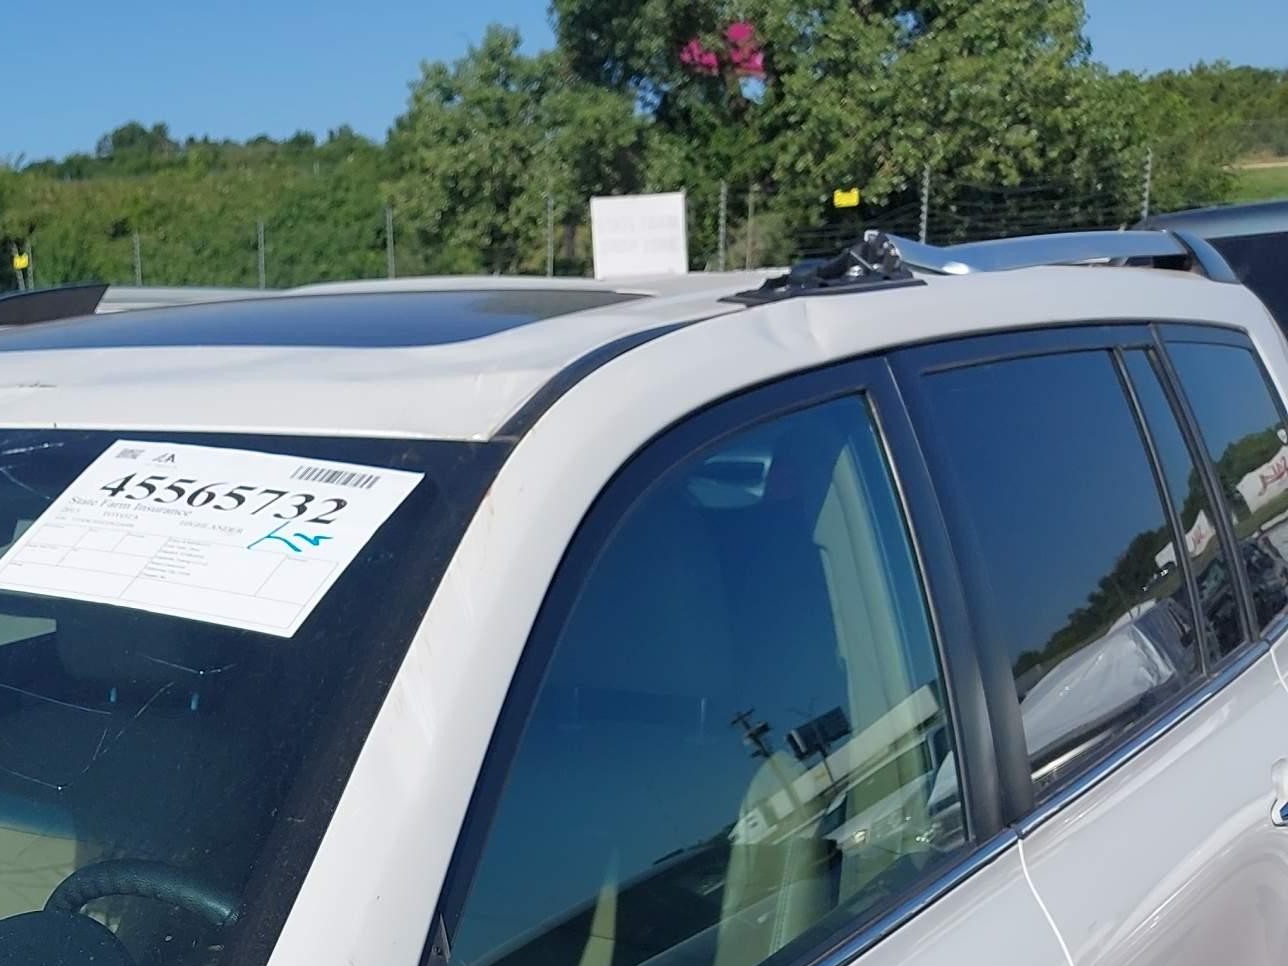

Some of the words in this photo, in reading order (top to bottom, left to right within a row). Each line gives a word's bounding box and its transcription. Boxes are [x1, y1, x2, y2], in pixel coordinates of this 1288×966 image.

[69, 496, 99, 508] State
[100, 498, 133, 511] Farm
[134, 501, 192, 517] Insurance
[101, 471, 348, 525] 45565732
